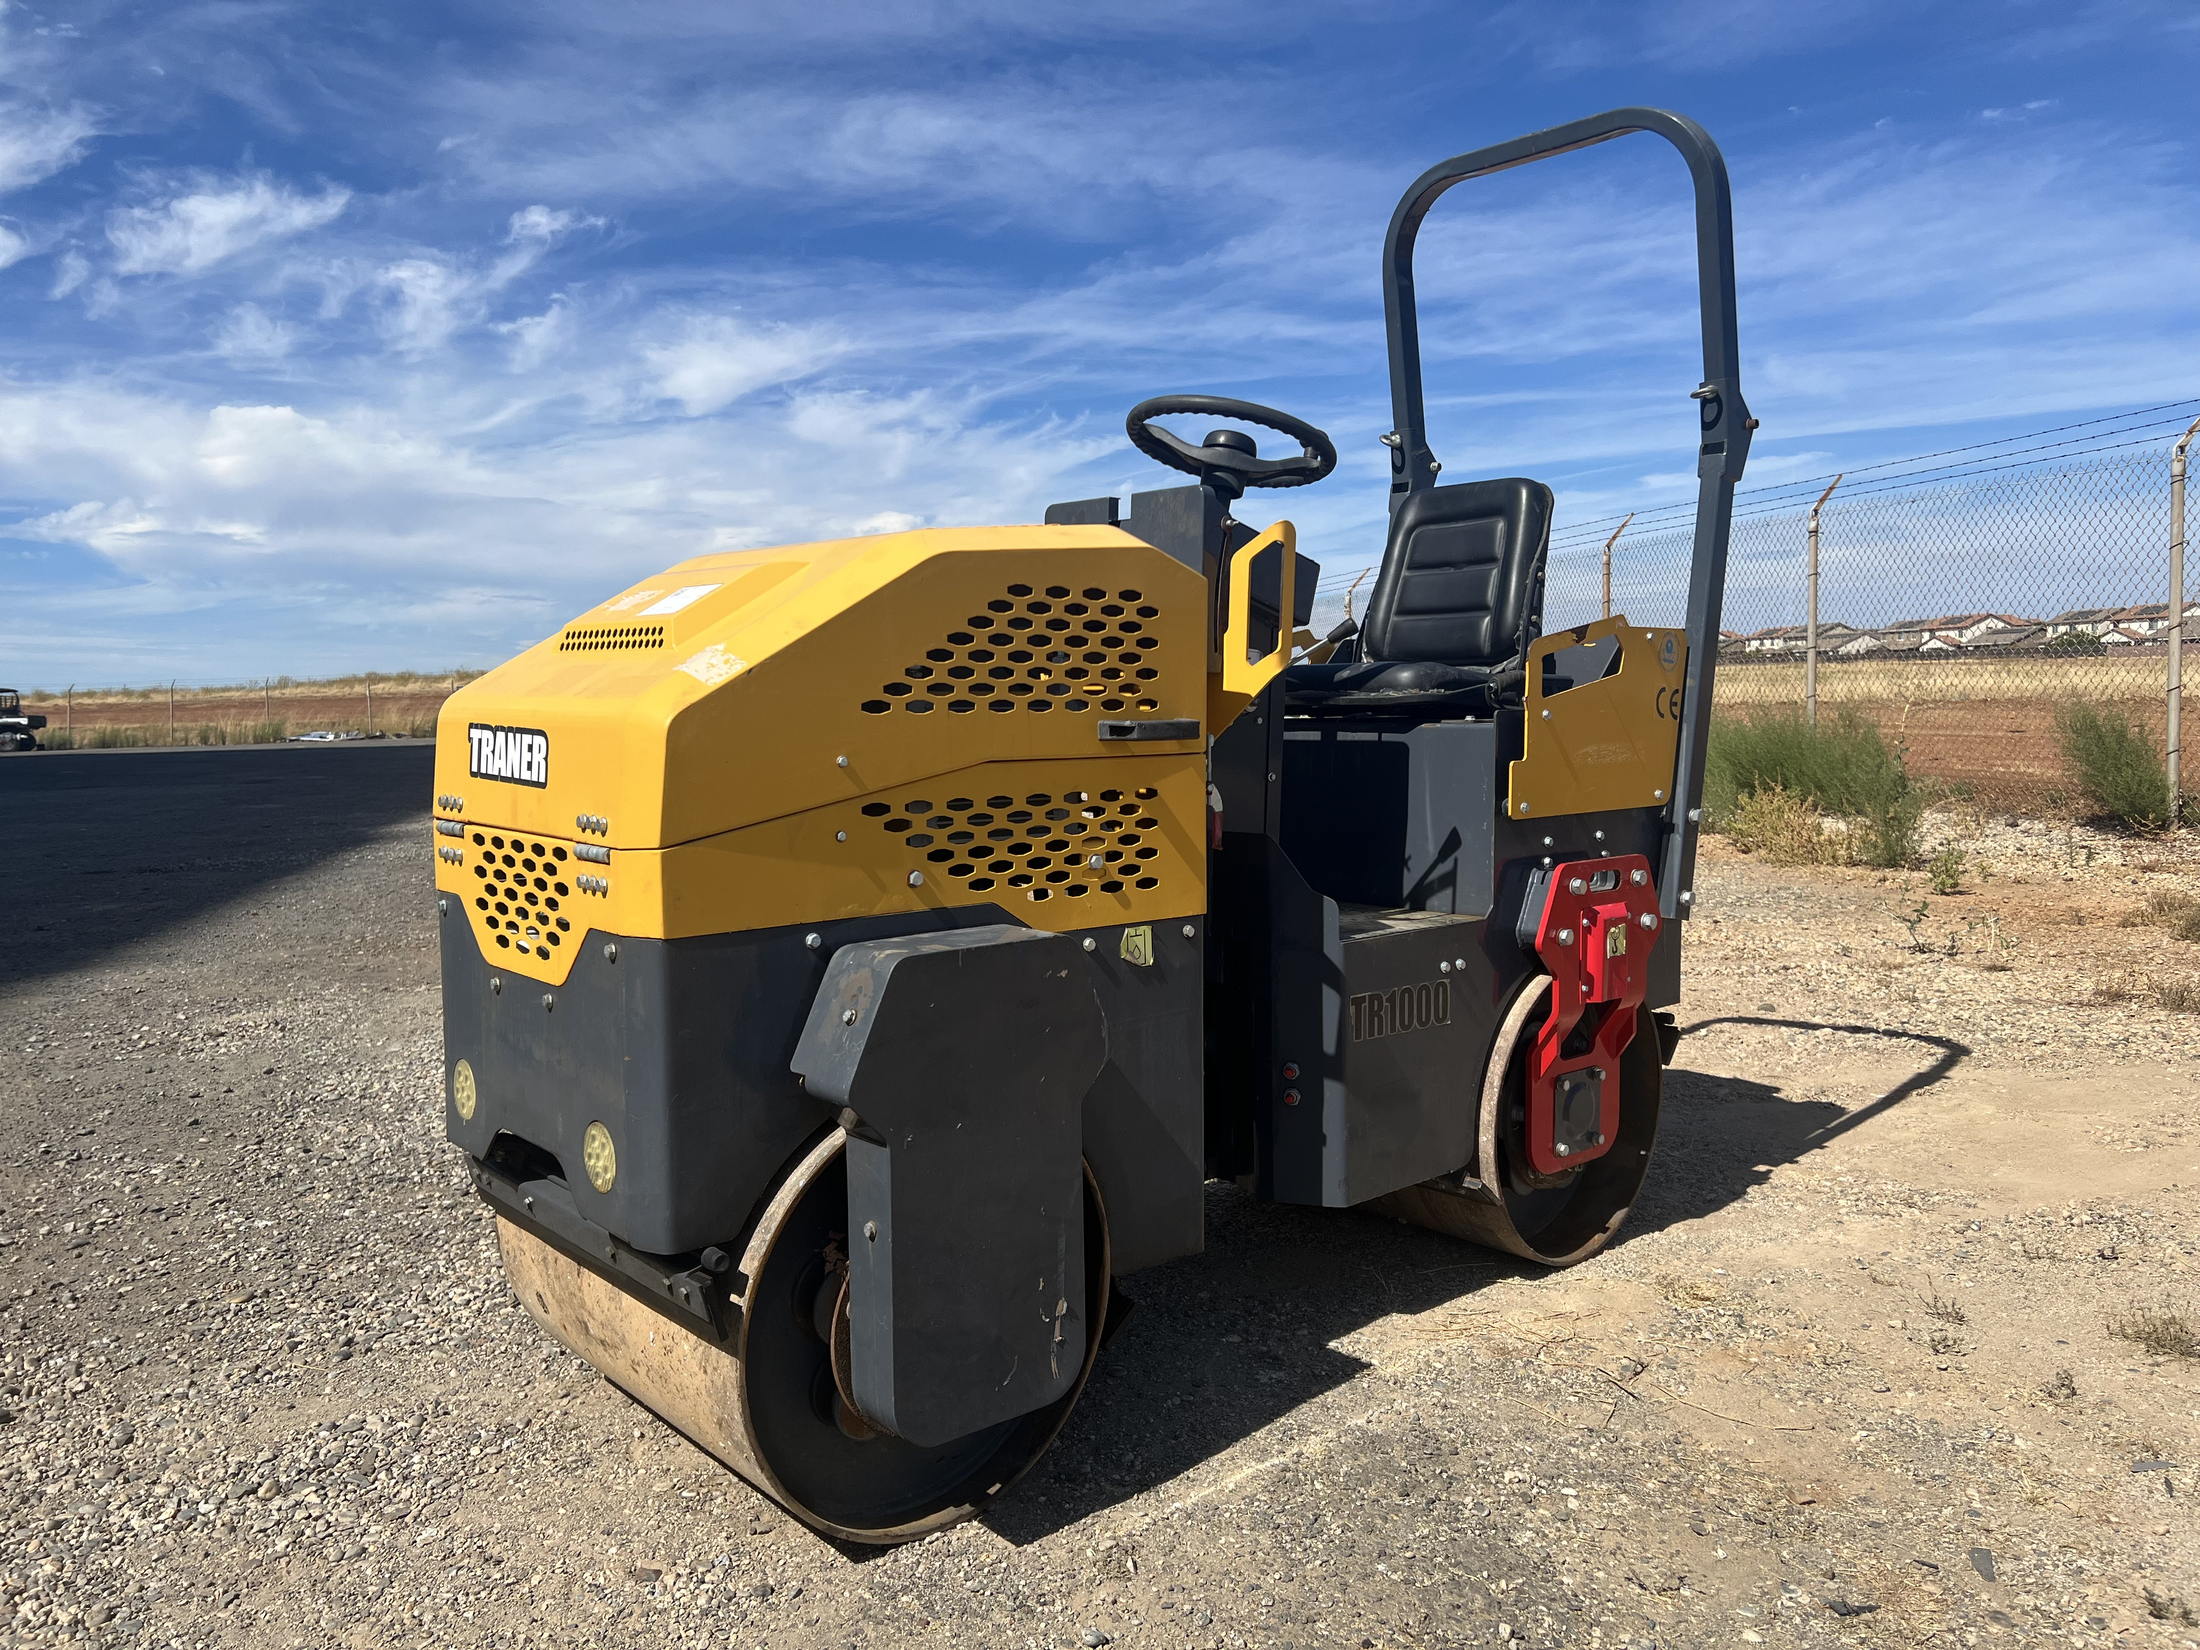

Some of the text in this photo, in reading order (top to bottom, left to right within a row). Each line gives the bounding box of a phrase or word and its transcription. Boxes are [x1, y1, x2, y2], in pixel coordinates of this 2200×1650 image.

[1656, 686, 1679, 720] CE
[469, 726, 548, 785] TRANER
[1350, 980, 1450, 1041] TR1000
